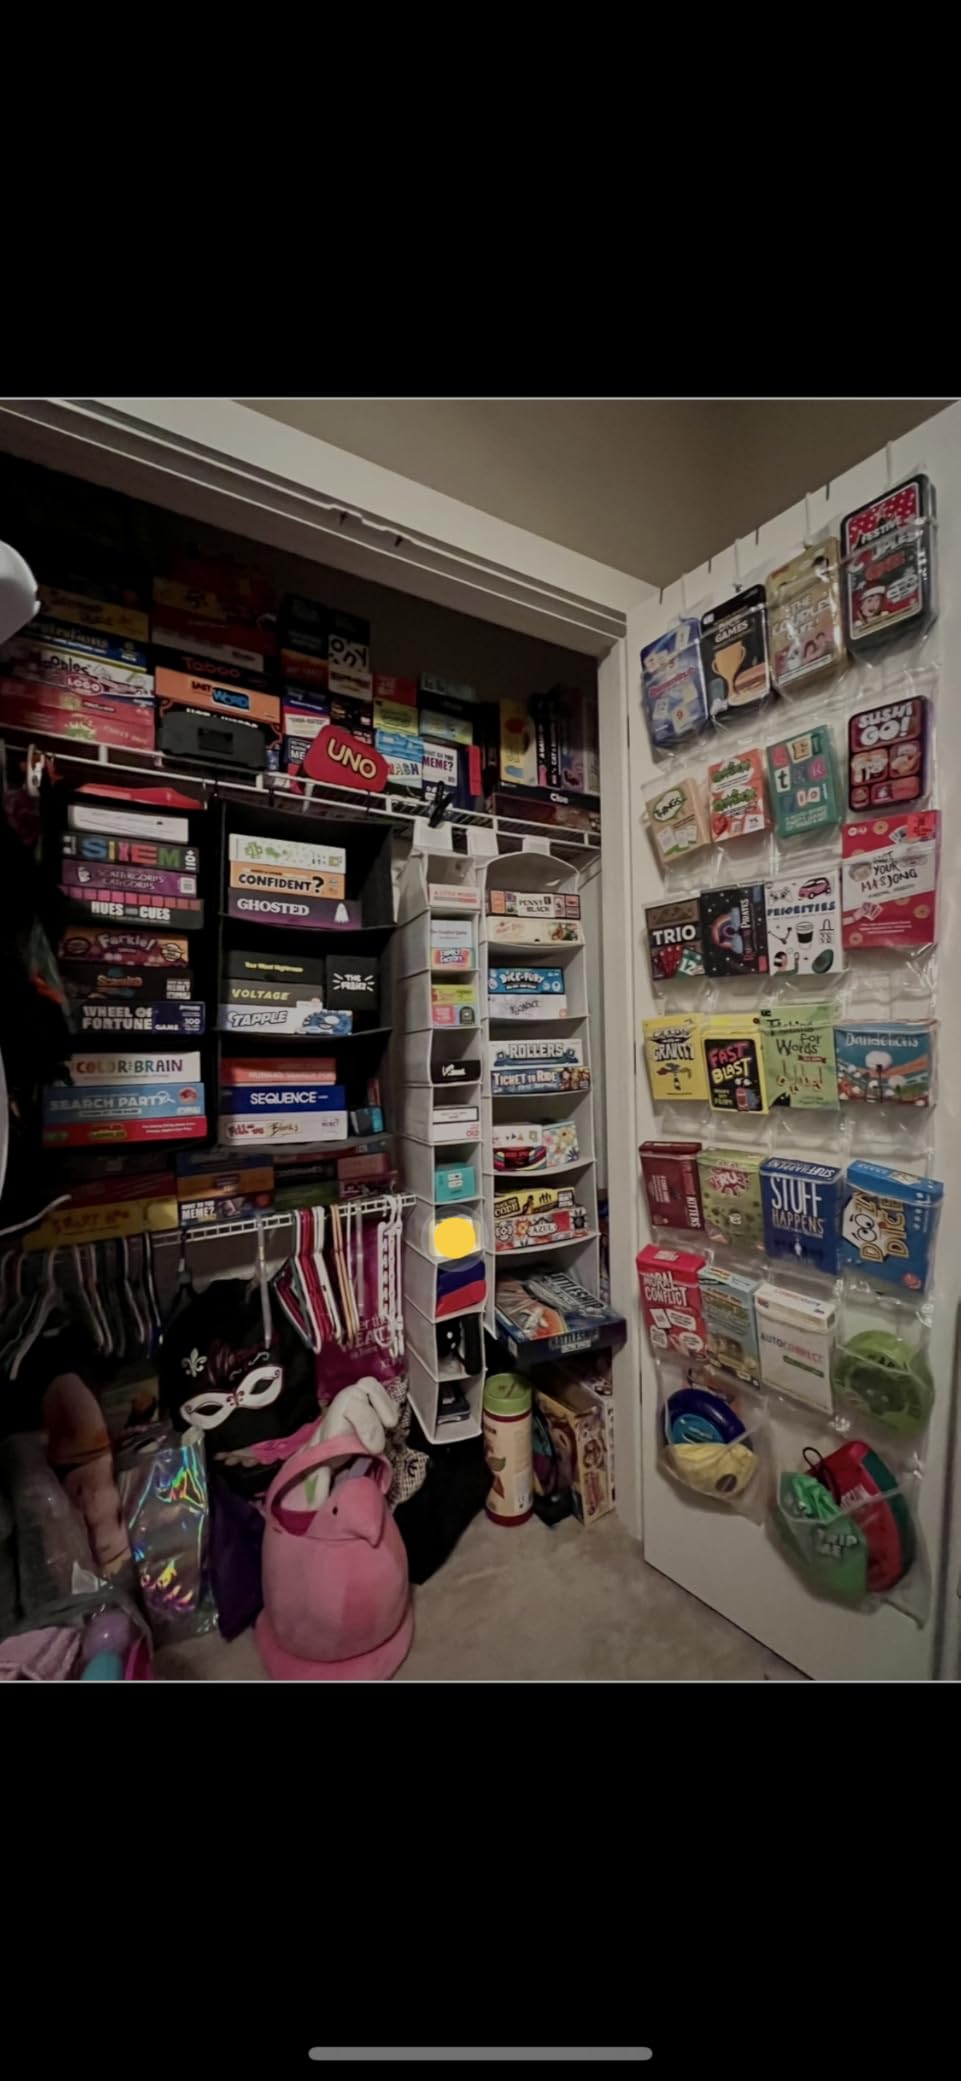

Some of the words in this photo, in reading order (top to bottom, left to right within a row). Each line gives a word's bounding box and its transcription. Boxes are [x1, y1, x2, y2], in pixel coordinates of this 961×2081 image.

[715, 622, 748, 643] GAMES
[857, 702, 913, 729] SUSHI
[860, 717, 911, 746] GO!
[327, 738, 377, 780] UNO
[873, 861, 900, 877] YOUR
[238, 874, 324, 893] CONFIDENT?
[91, 901, 124, 917] HUES
[140, 905, 171, 921] CUES
[237, 898, 310, 917] GHOSTED
[526, 906, 550, 914] BLACK
[741, 897, 753, 930] PIRATES
[767, 900, 836, 917] PRIORITIES
[653, 924, 696, 946] TRIO
[343, 974, 362, 982] THE
[231, 988, 291, 1001] VOLTAGE
[83, 1004, 133, 1018] WHEEL
[134, 1006, 153, 1017] OF
[229, 1010, 289, 1028] TAPPLE
[82, 1018, 153, 1030] FORTUNE
[509, 1043, 565, 1060] ROLLERS
[654, 1043, 696, 1061] GRAVITY
[708, 1041, 749, 1067] FAST
[776, 1039, 818, 1057] Words
[76, 1061, 128, 1074] COLOR
[134, 1059, 183, 1074] BRAIN
[711, 1057, 752, 1084] BLAST
[49, 1095, 114, 1111] SEARCH
[118, 1094, 165, 1108] PARTY
[250, 1091, 318, 1105] SEQUENCE
[770, 1175, 823, 1218] STUFF
[686, 1196, 702, 1229] KITTENS
[772, 1206, 826, 1240] HAPPENS
[878, 1199, 910, 1259] DICE
[644, 1286, 689, 1307] CONFLICT
